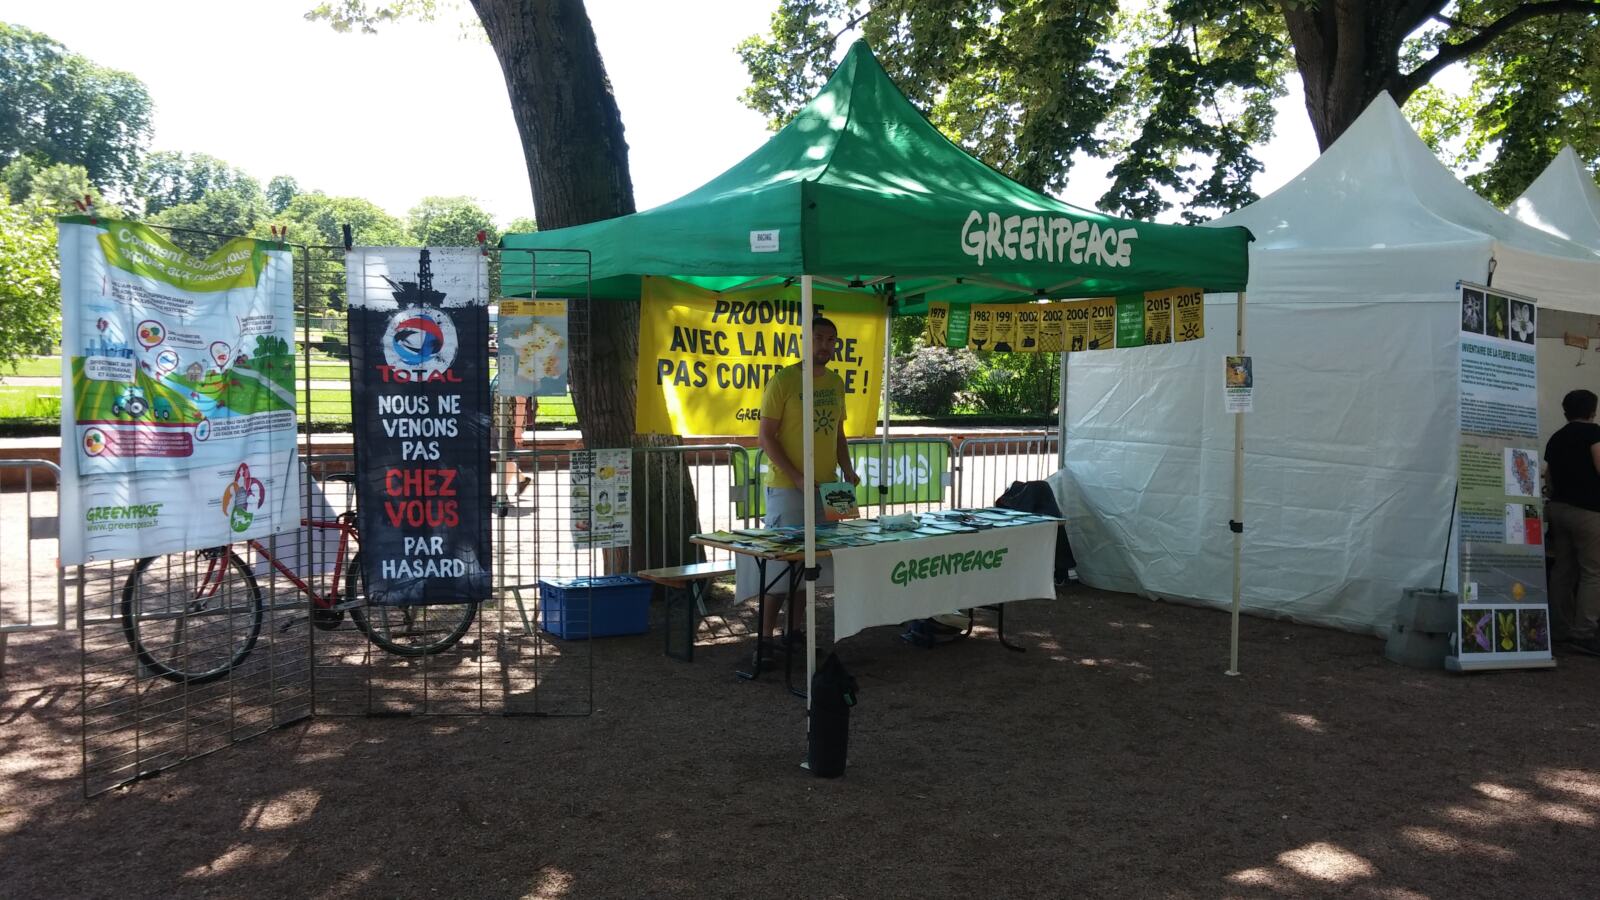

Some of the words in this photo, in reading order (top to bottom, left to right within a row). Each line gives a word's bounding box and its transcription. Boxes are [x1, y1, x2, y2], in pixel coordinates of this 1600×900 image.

[961, 210, 1138, 267] GREENPEACE
[1147, 298, 1170, 311] 2015
[1177, 292, 1201, 308] 2015
[711, 300, 824, 326] PRODUIE
[930, 308, 946, 319] 1978
[974, 311, 990, 321] 1982
[996, 311, 1012, 321] 1991
[1019, 311, 1038, 321] 2002
[1043, 310, 1063, 321] 2002
[1067, 308, 1089, 320] 2006
[1092, 306, 1114, 318] 2010
[670, 326, 730, 356] AVEC
[737, 331, 766, 357] LA
[773, 332, 864, 366] NARE,
[376, 365, 463, 383] TOTAL
[656, 358, 708, 388] PAS
[378, 395, 430, 415] NOUS
[438, 395, 461, 415] NE
[382, 418, 458, 437] VENONS
[402, 441, 440, 460] PAS
[385, 468, 457, 496] CHEZ
[86, 504, 163, 521] GREENPEACE
[384, 500, 459, 528] VOUS
[404, 536, 443, 556] PAR
[382, 559, 465, 579] HASARD
[891, 548, 1008, 587] GREENPEACE
